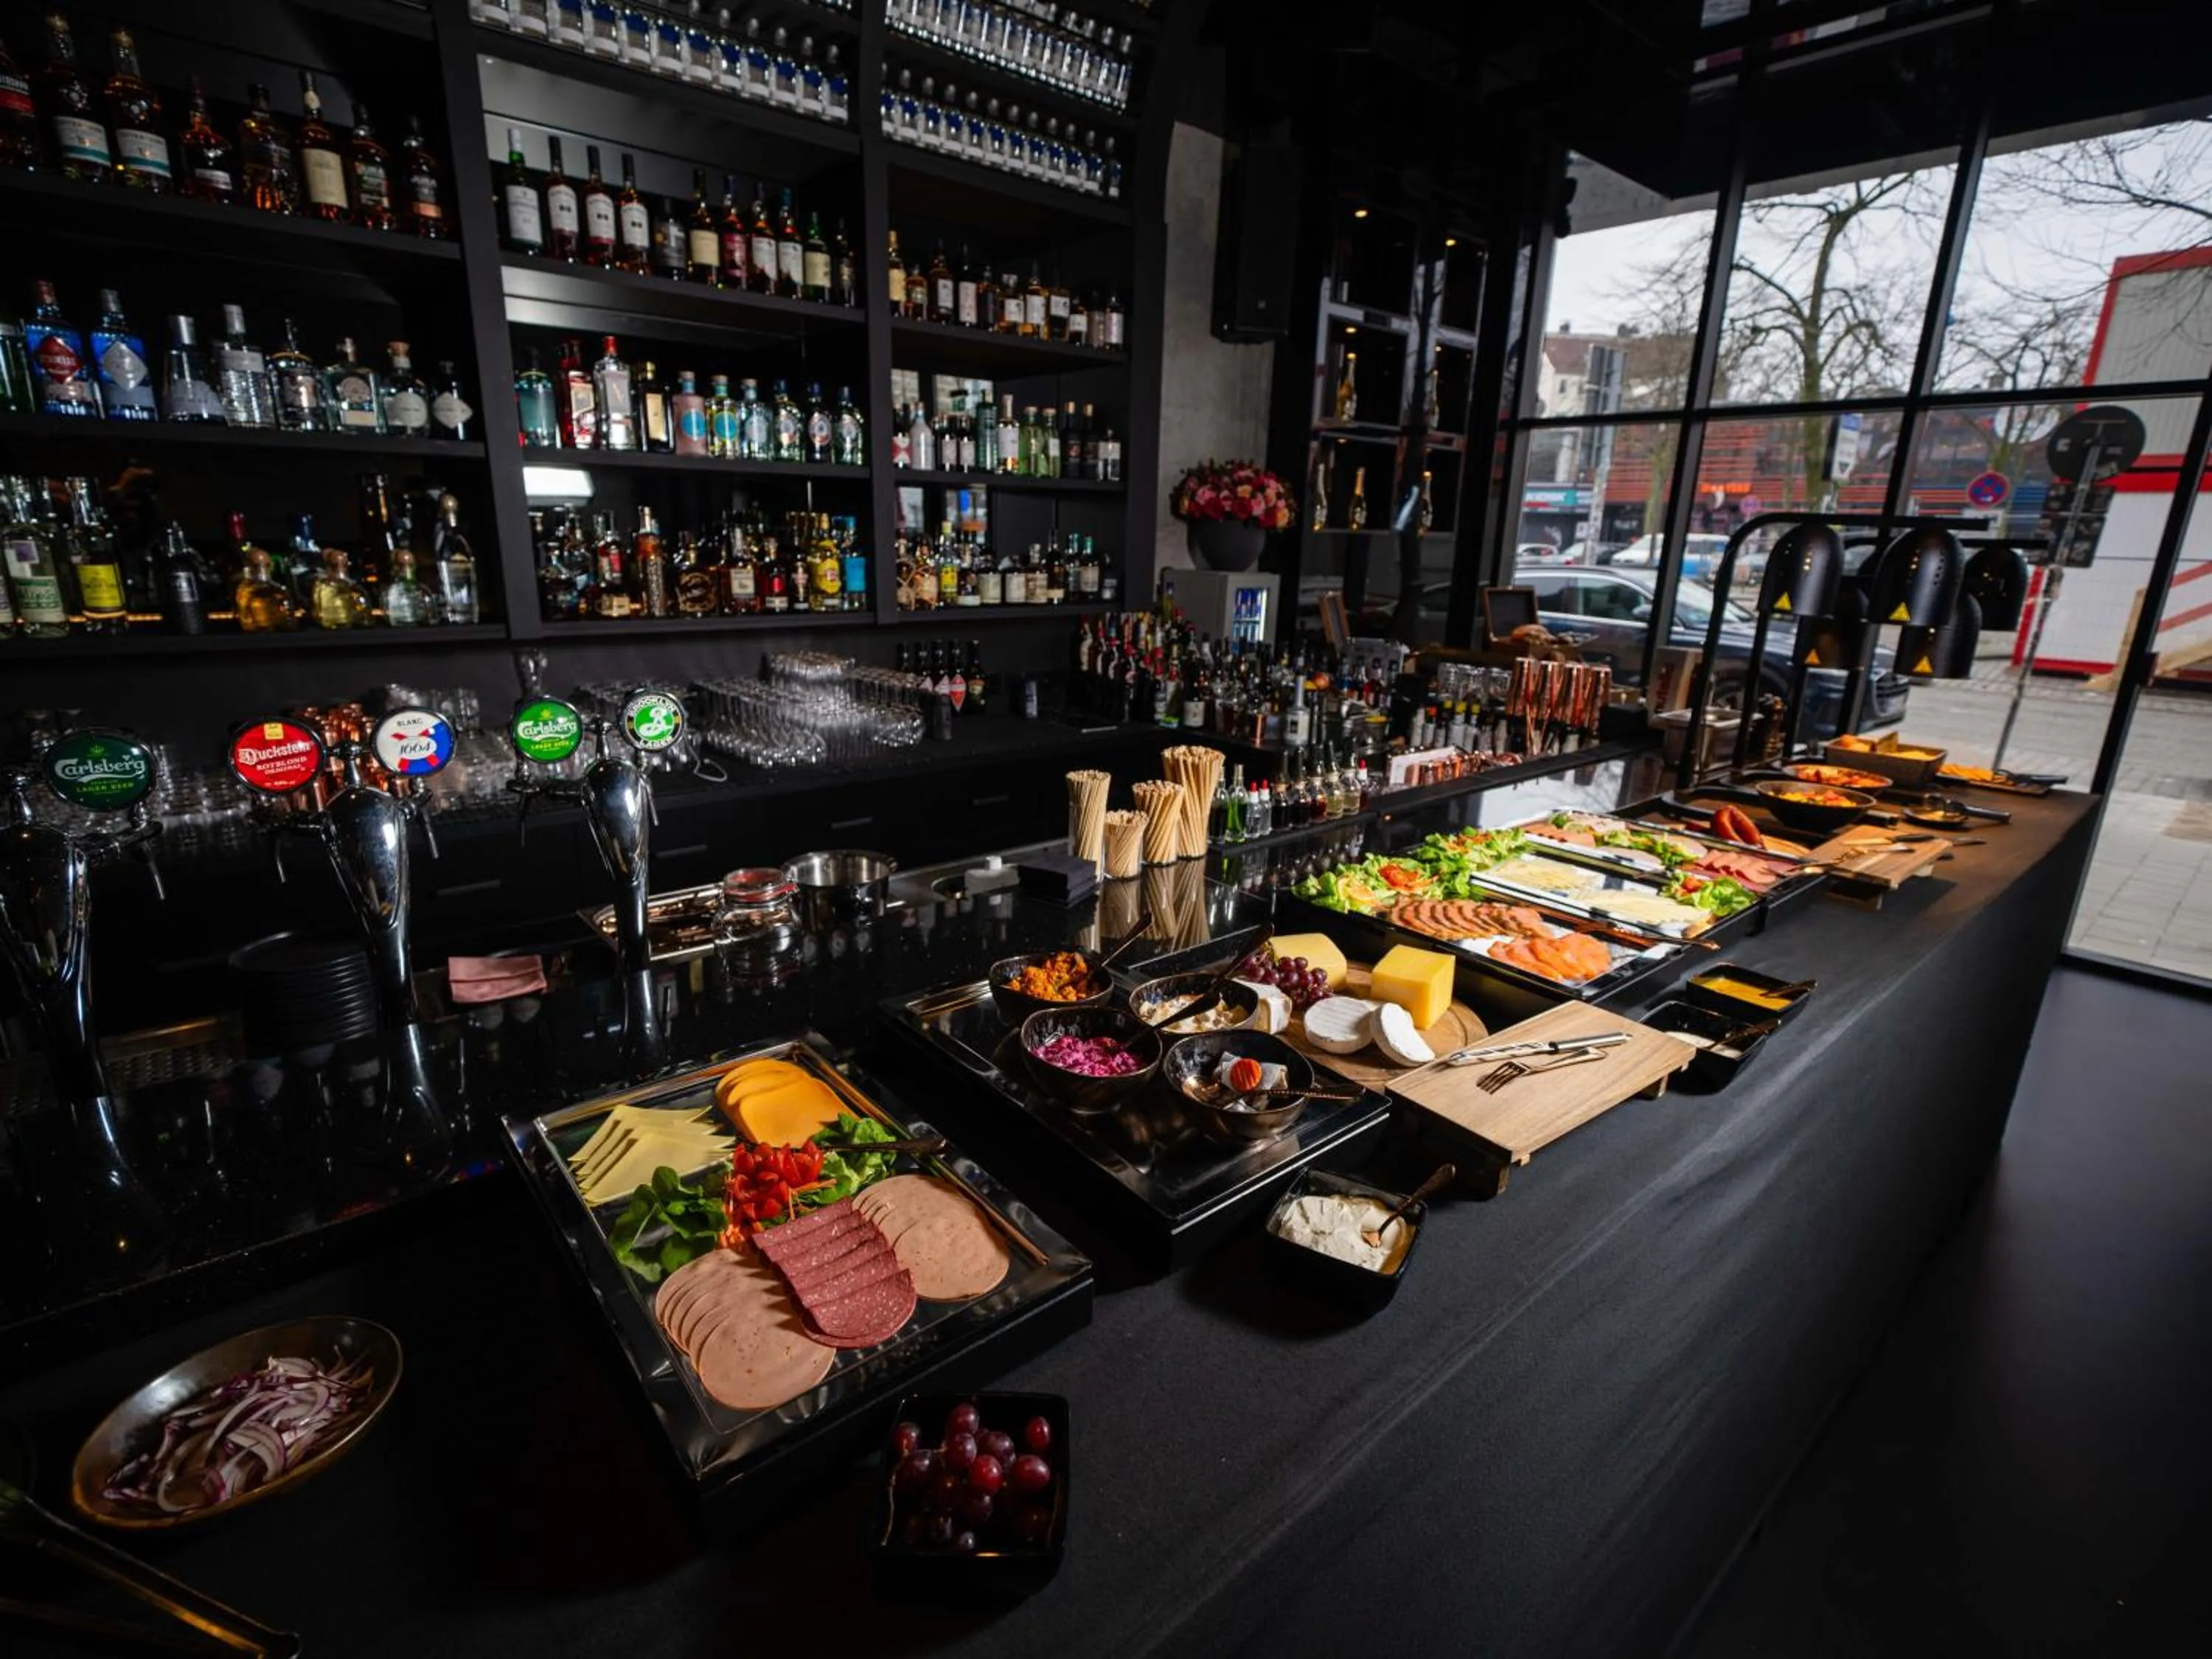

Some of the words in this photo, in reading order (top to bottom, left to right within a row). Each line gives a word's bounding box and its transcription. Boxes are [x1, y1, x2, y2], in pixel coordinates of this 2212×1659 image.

[626, 695, 678, 715] BROOKLYN
[397, 717, 424, 728] BLANC
[518, 714, 577, 741] Carlsberg
[400, 742, 431, 753] 1664
[637, 737, 674, 750] LAGER
[238, 740, 311, 765] Duckstein
[55, 754, 145, 783] Carlsberg
[76, 785, 107, 793] LAGER
[111, 781, 134, 790] BEER
